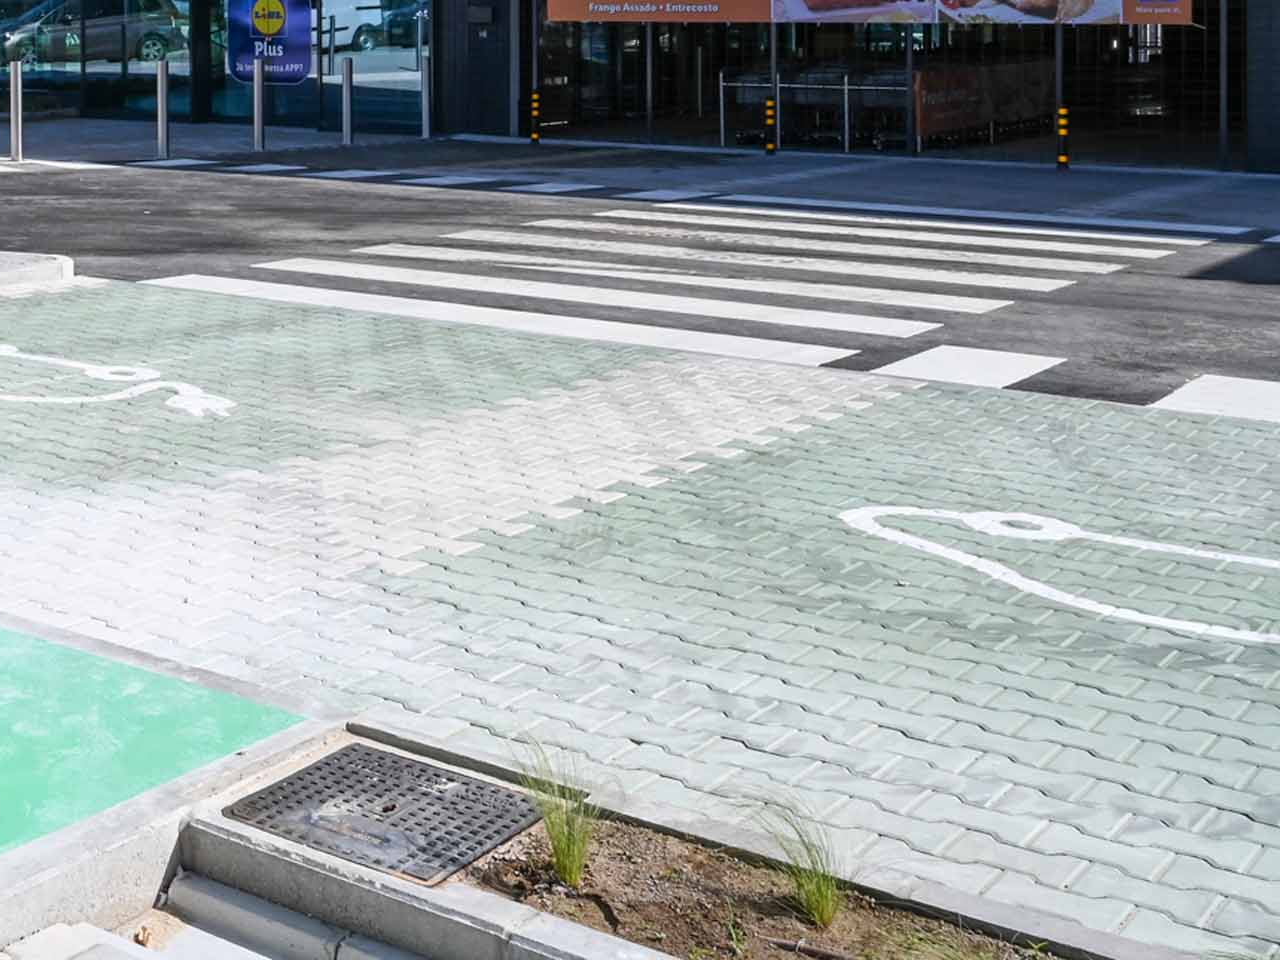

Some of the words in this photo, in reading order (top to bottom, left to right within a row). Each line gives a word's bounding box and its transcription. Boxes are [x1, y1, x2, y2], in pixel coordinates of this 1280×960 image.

[588, 2, 621, 13] Frango
[623, 3, 657, 12] Assado
[665, 3, 719, 12] Entrecosto
[254, 41, 284, 57] Plus
